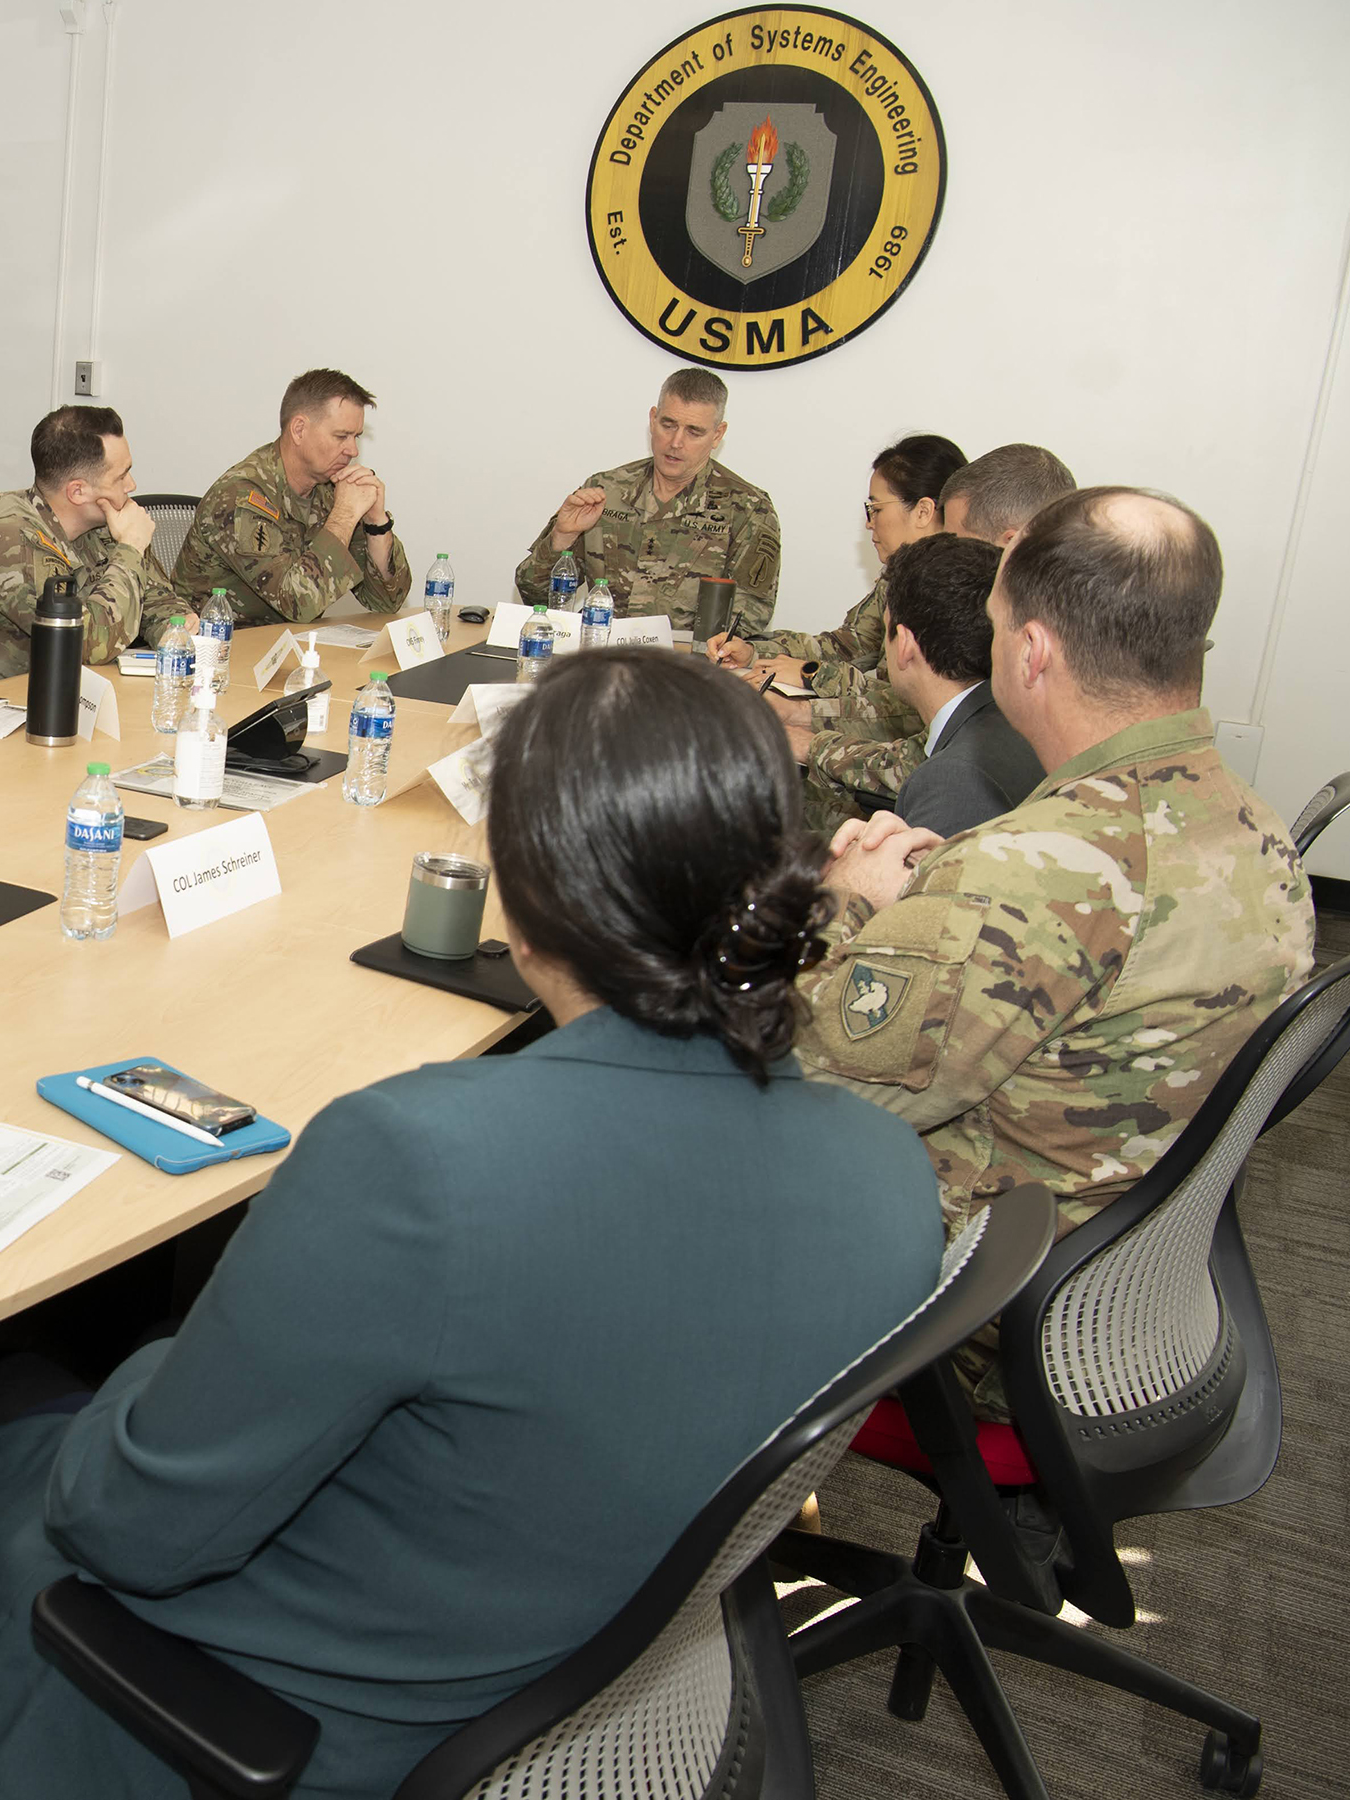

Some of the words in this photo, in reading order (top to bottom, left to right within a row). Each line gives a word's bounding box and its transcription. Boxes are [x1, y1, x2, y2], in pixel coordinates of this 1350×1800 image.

[610, 51, 704, 166] Department
[713, 34, 733, 61] of
[751, 24, 846, 61] Systems
[849, 49, 923, 176] Engineering
[607, 210, 624, 256] Est.
[868, 225, 909, 281] 1989
[658, 297, 834, 355] USMA
[701, 523, 727, 533] ARMY
[74, 826, 115, 842] DASANI
[173, 876, 193, 893] COL
[194, 865, 222, 887] James
[221, 850, 262, 874] Schreiner
